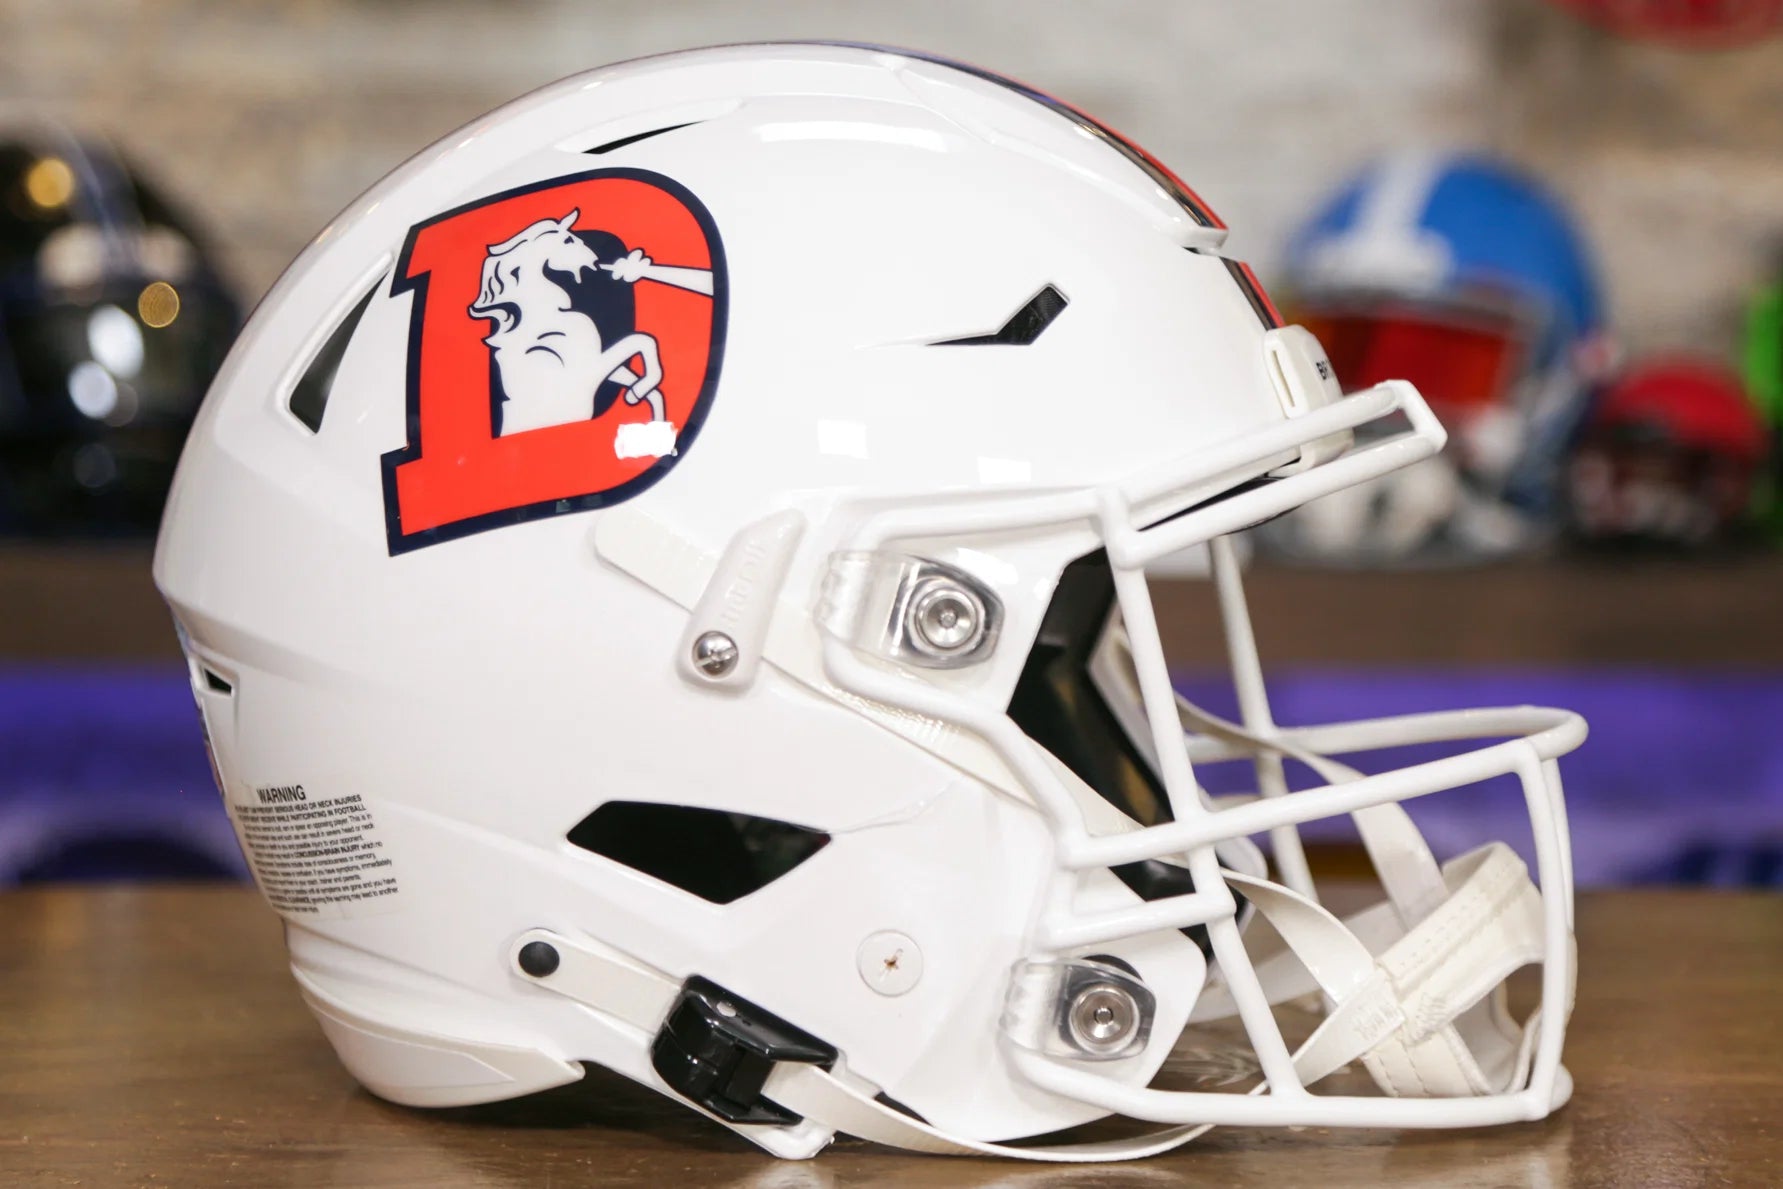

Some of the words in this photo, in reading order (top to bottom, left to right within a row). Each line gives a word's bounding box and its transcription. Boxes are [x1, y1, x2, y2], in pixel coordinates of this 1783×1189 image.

[256, 785, 306, 804] WARNING
[294, 803, 309, 811] HEAD
[317, 799, 334, 808] NECK
[334, 794, 362, 805] INJURIES
[290, 811, 327, 821] PARTICIPATING
[334, 803, 367, 815] FOOTBALL
[348, 814, 361, 822] This
[361, 822, 374, 831] neck
[340, 844, 360, 853] INJURY
[361, 858, 392, 869] immediately
[349, 882, 362, 891] gone
[362, 880, 373, 888] and
[373, 880, 383, 889] you
[383, 877, 396, 886] have
[362, 889, 373, 897] lead
